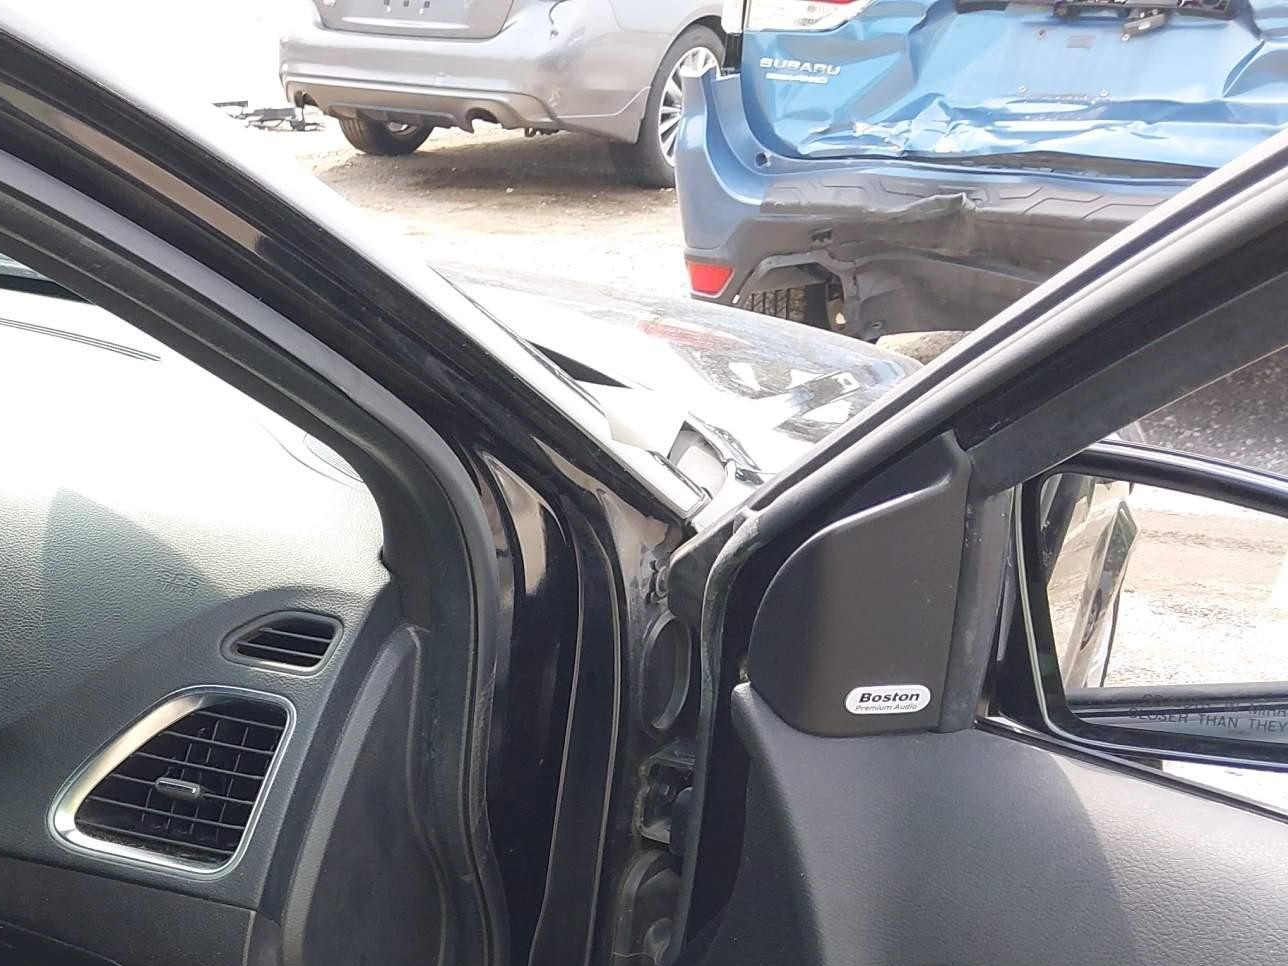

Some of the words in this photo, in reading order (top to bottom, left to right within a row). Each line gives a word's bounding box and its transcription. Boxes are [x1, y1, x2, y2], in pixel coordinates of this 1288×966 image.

[759, 57, 841, 75] SUBARU
[859, 692, 920, 703] Boston
[854, 703, 892, 712] Premium
[894, 703, 918, 711] Audio
[1199, 713, 1239, 729] THAN
[1248, 718, 1288, 732] THEY
